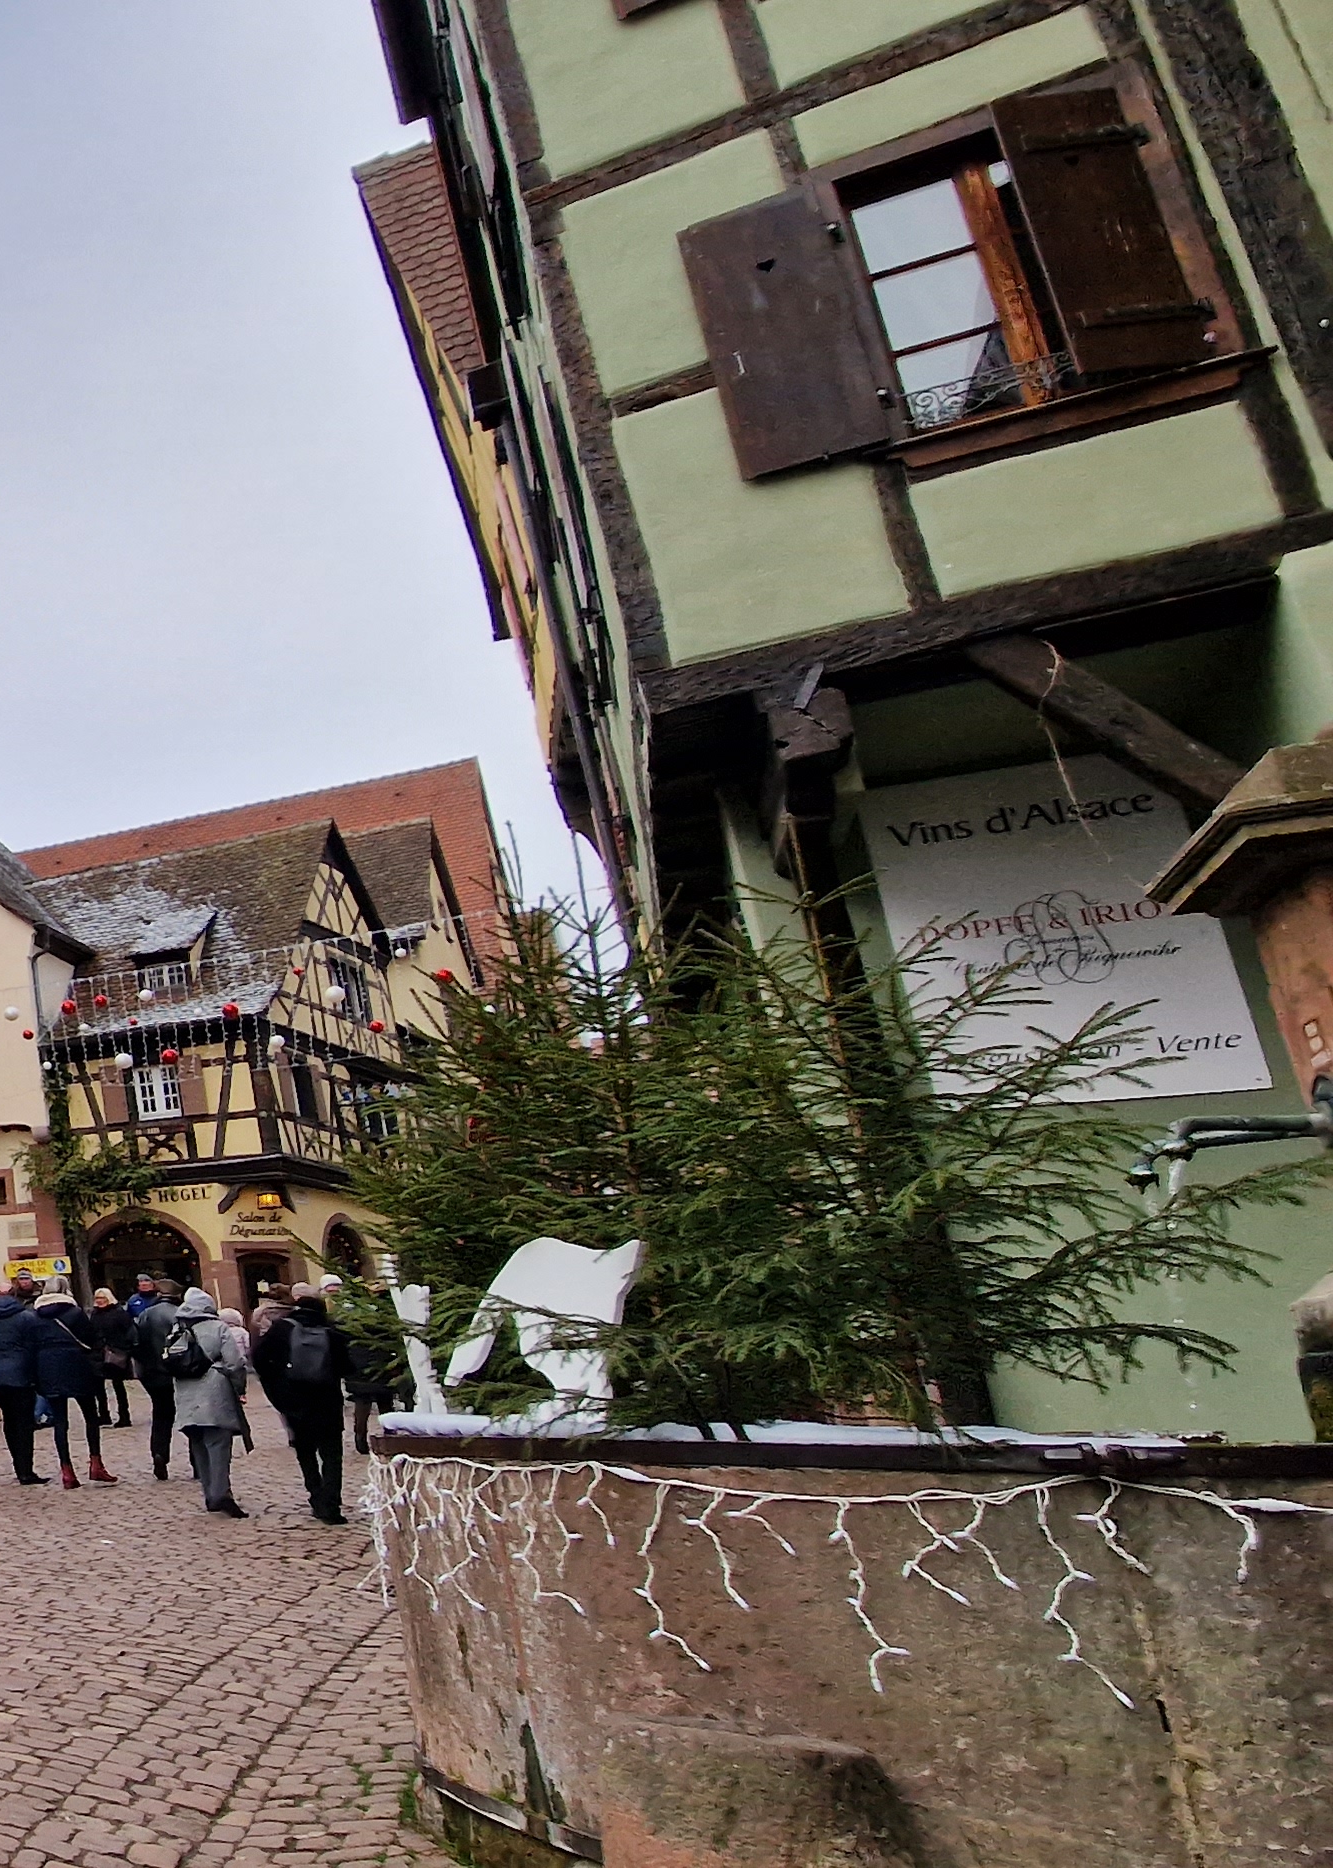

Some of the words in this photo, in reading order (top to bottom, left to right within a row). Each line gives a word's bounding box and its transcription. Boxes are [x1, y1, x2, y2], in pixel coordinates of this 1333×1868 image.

[886, 819, 974, 847] Vins
[985, 793, 1155, 834] d'Alsace
[1078, 899, 1167, 927] IRIO
[1156, 1032, 1242, 1055] Vente
[236, 1211, 265, 1223] Salon
[268, 1211, 282, 1223] de
